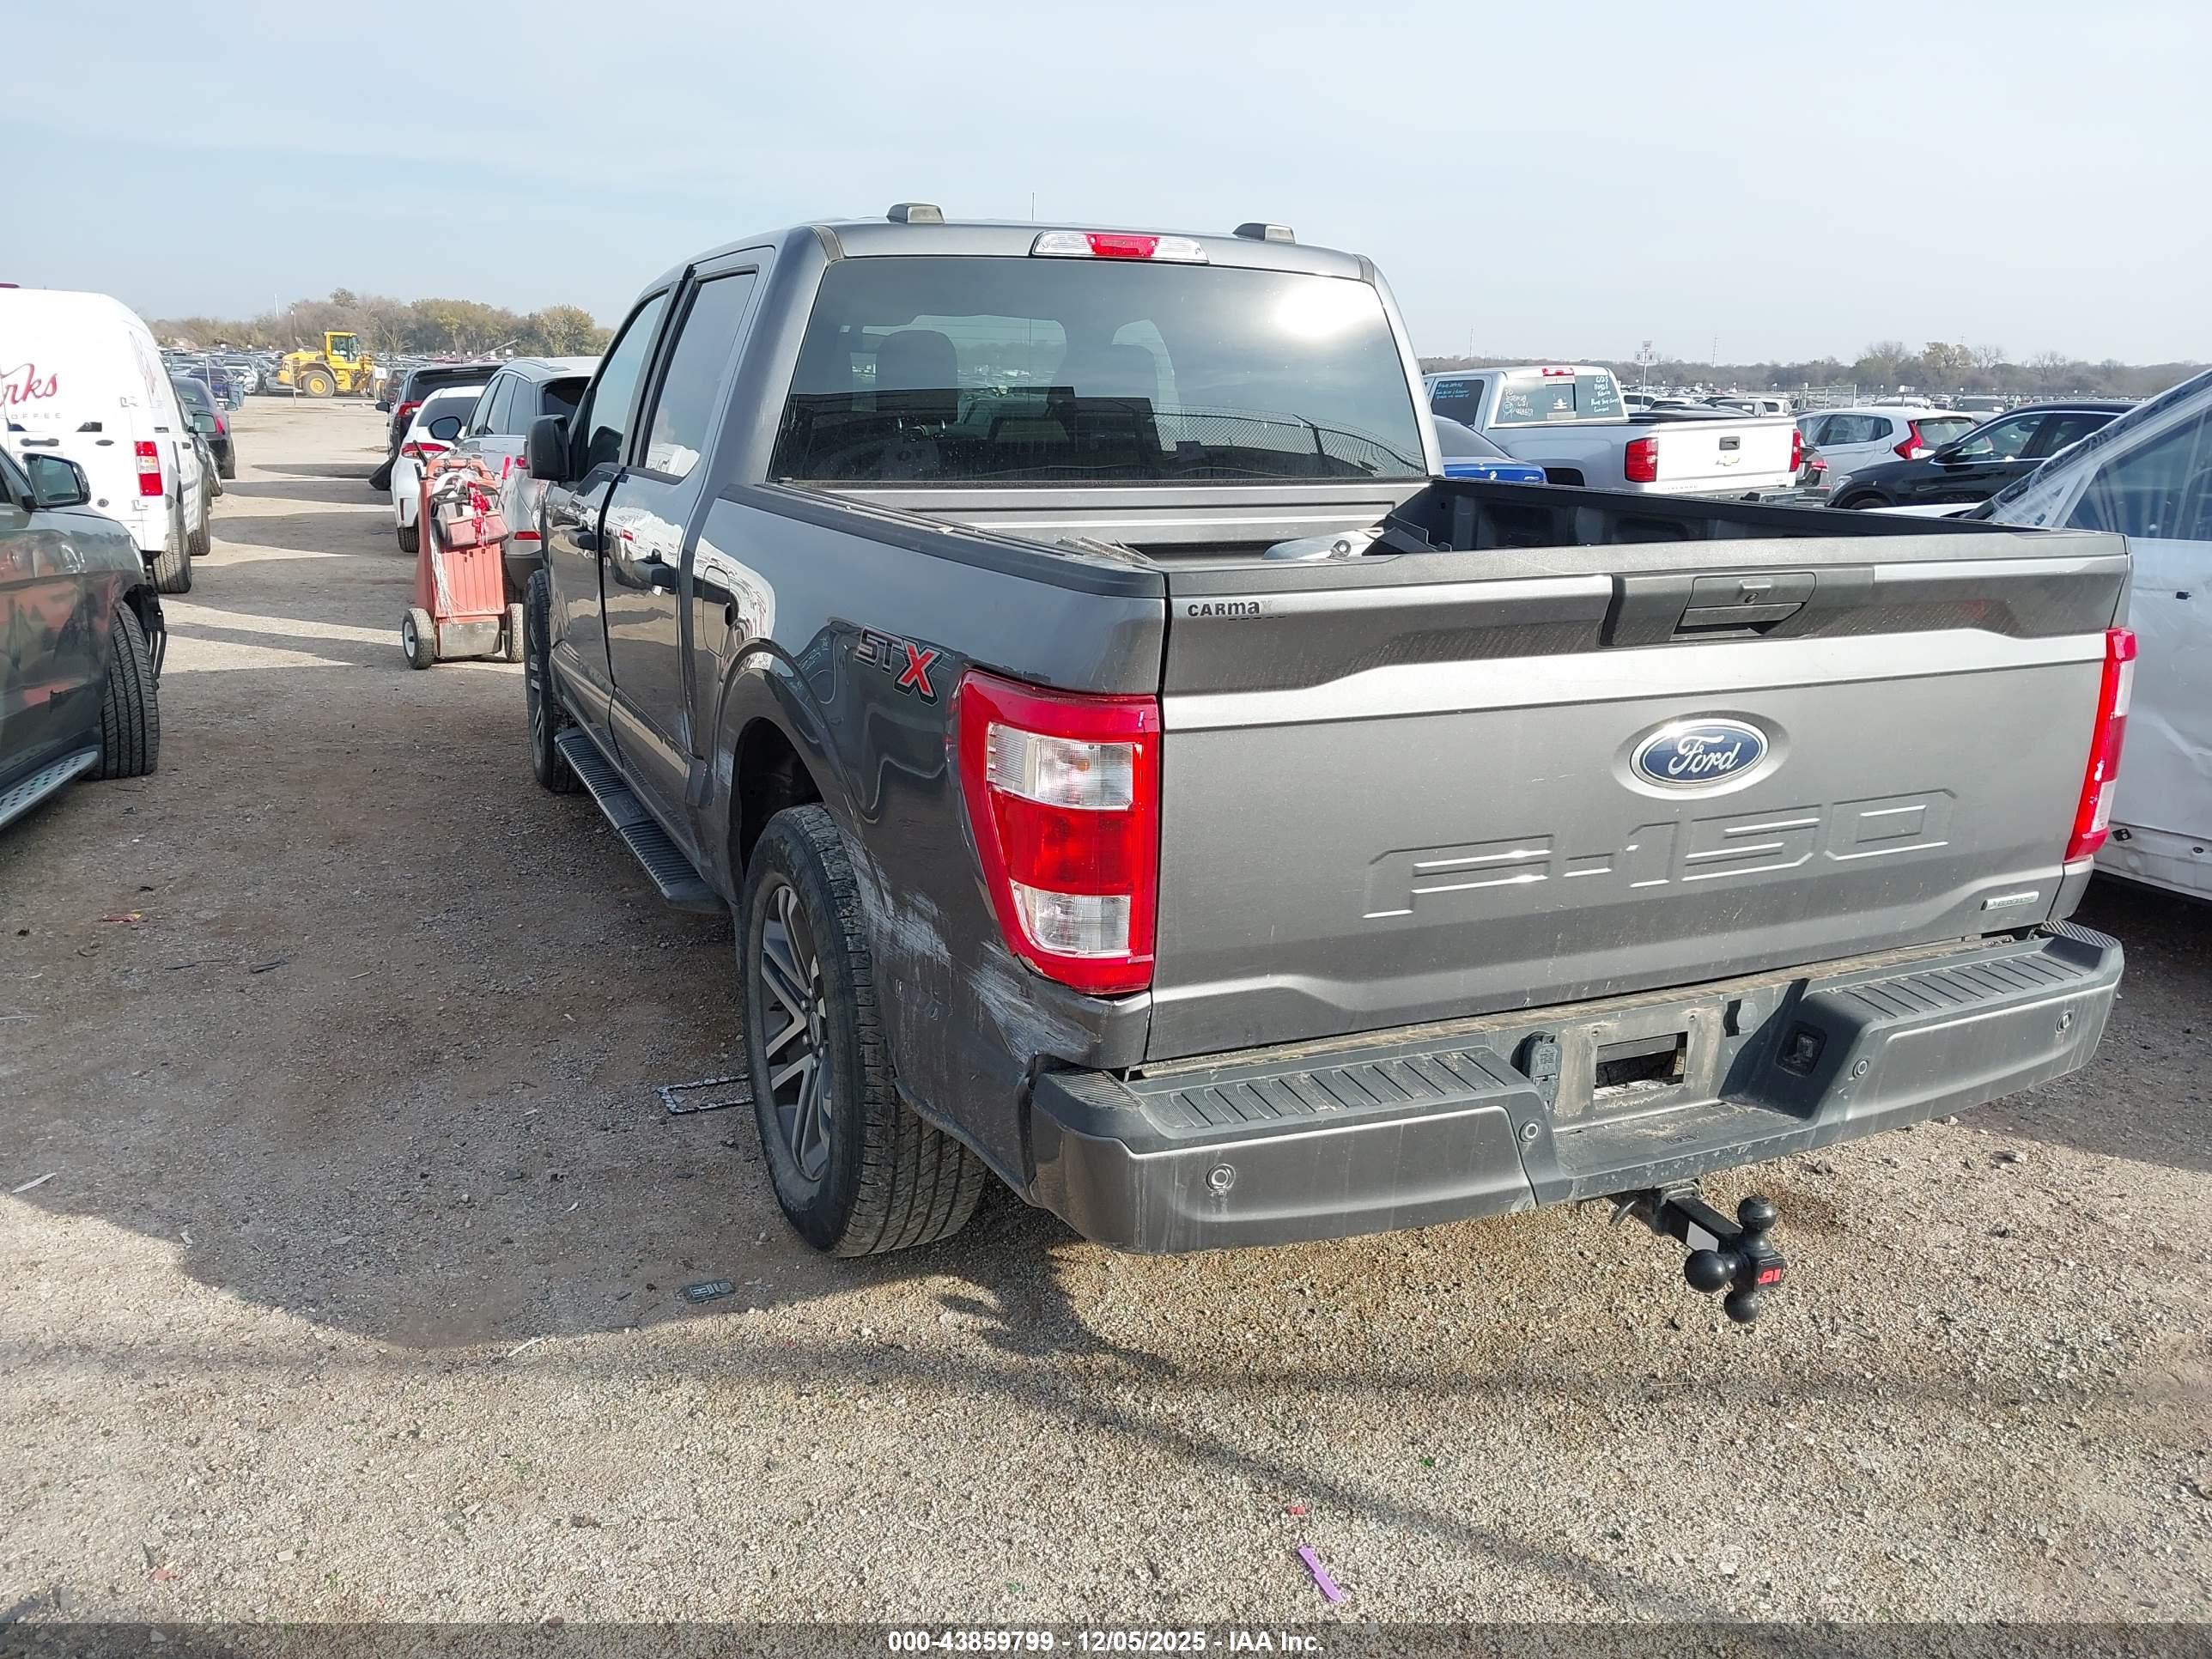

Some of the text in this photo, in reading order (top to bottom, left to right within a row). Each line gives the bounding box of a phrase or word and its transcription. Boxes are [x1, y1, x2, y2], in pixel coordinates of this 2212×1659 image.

[854, 624, 945, 707] STX
[1668, 734, 1741, 775] Ford
[1364, 789, 1959, 919] F-150
